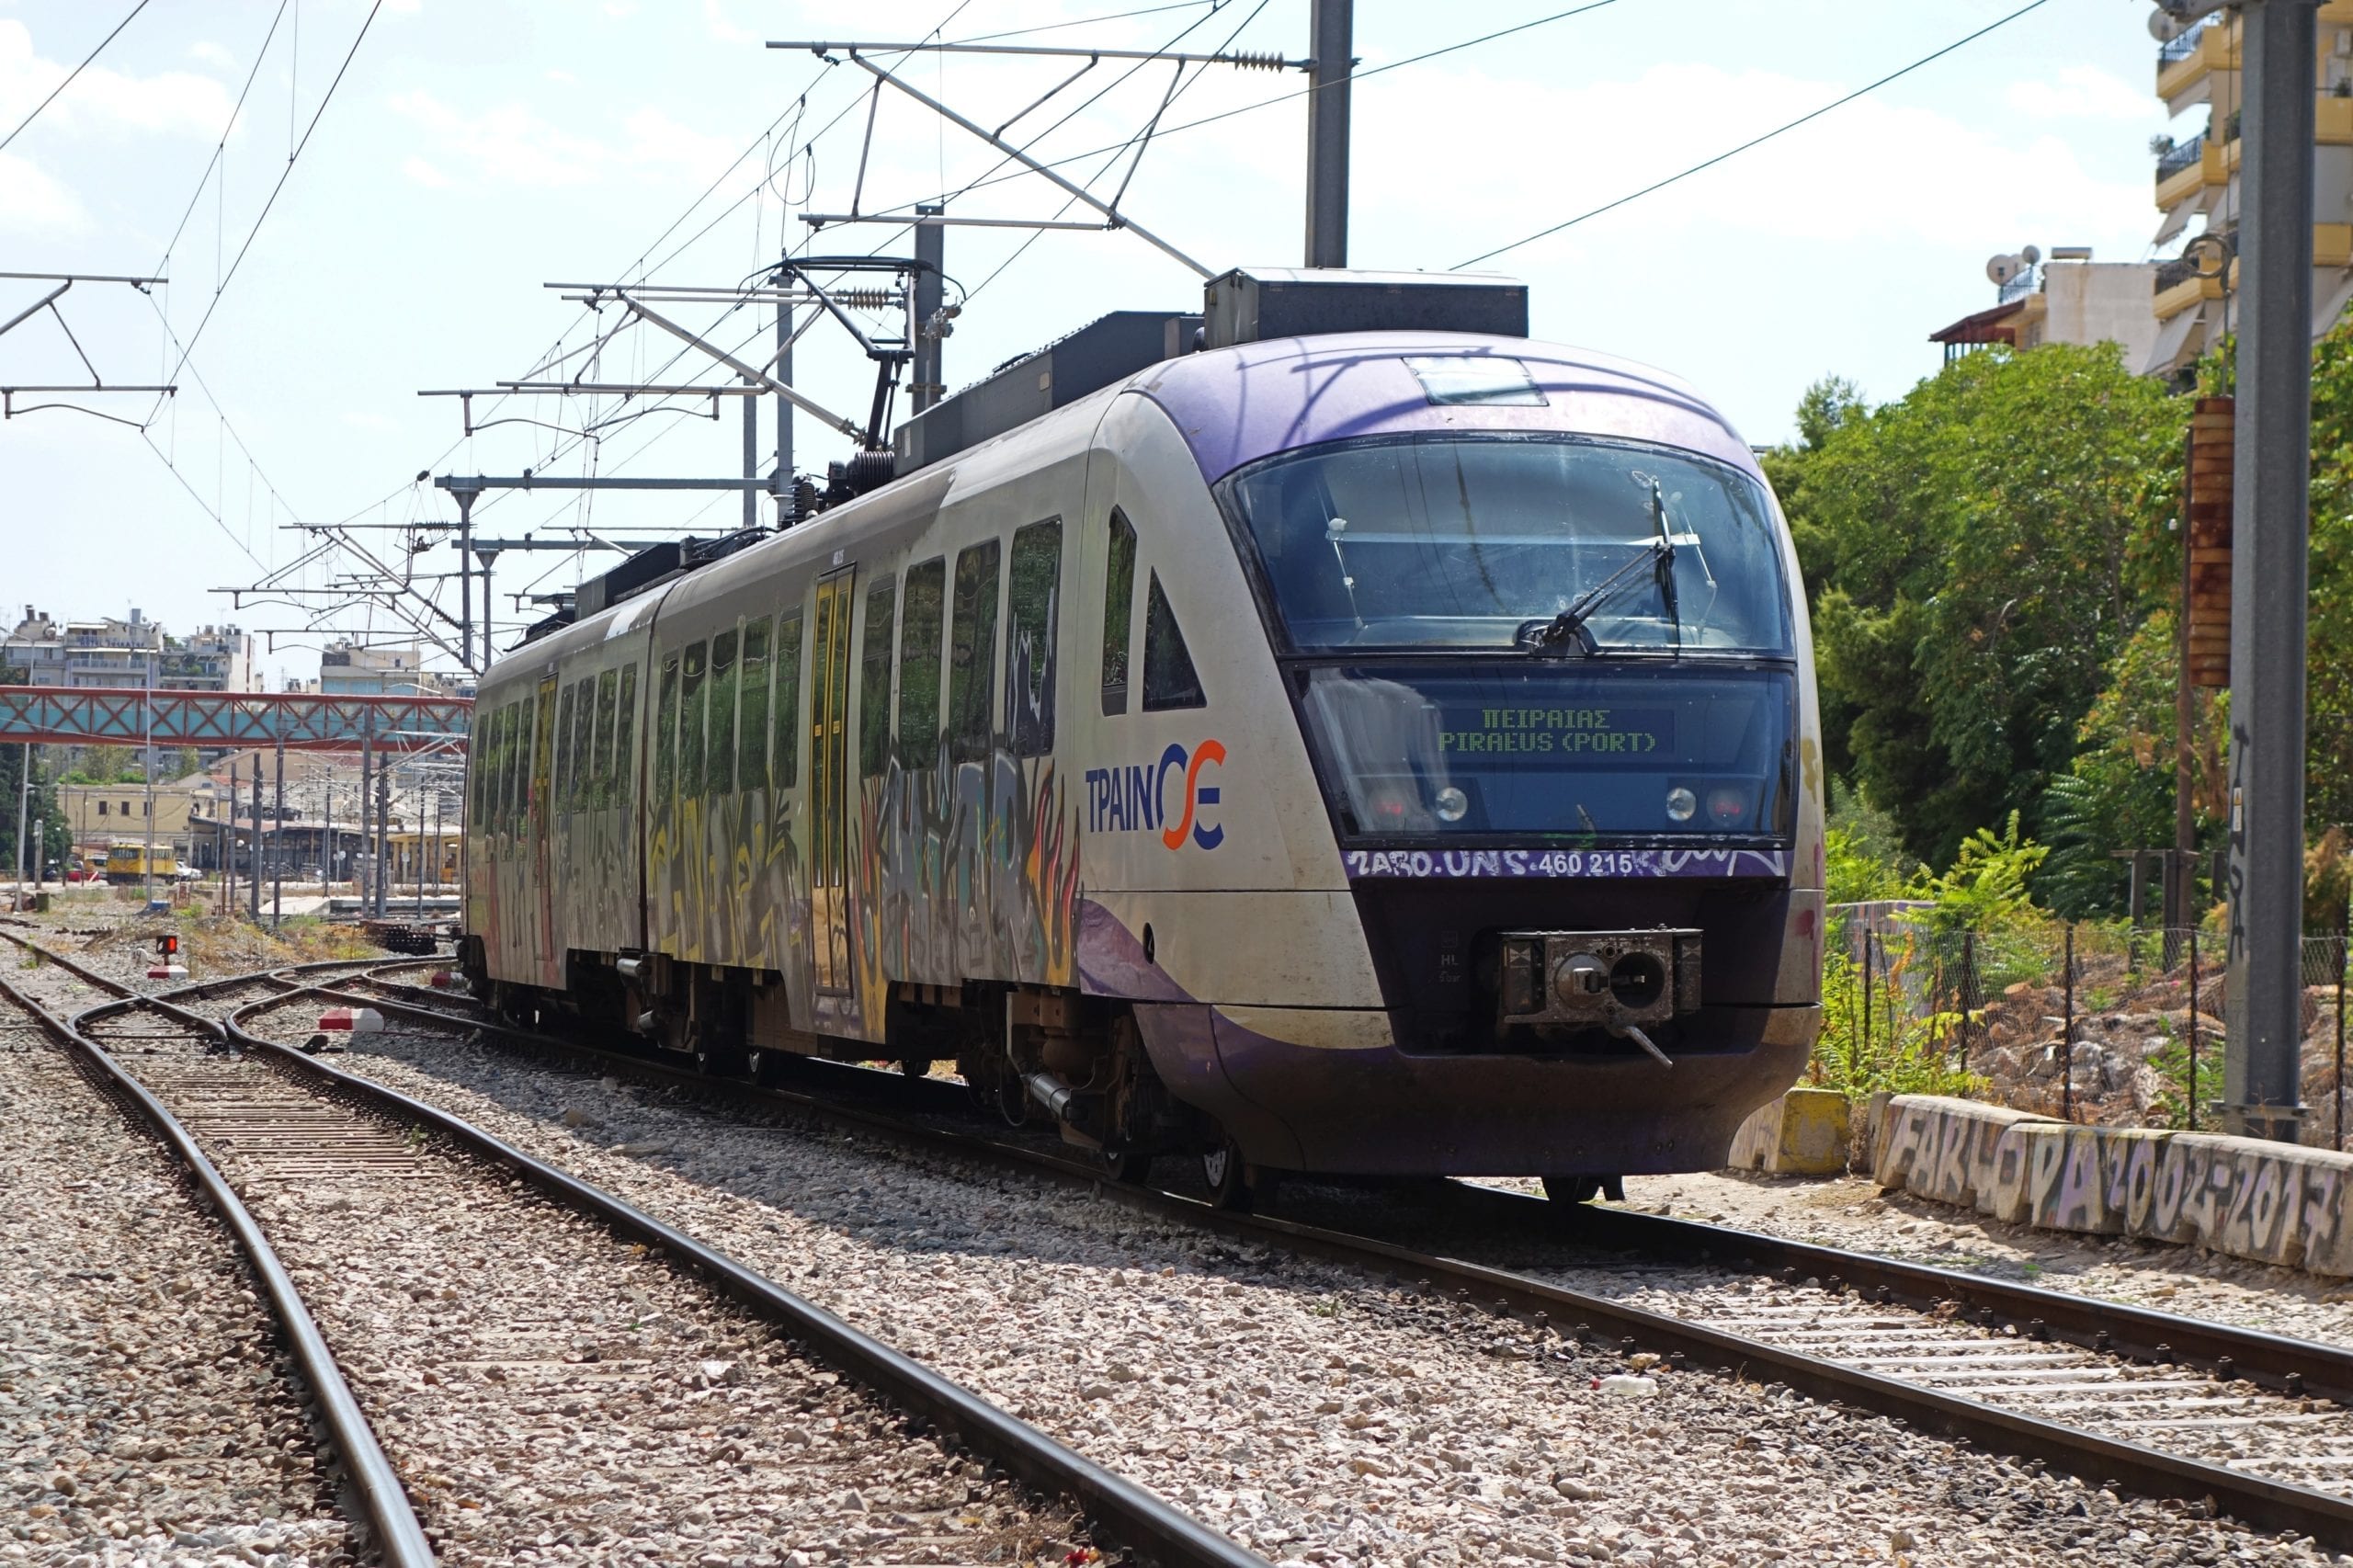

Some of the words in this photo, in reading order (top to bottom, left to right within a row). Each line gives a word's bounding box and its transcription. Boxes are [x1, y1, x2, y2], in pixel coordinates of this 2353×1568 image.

[1482, 710, 1610, 728] ΠΕΙΡΑΙΑΣ
[1438, 733, 1553, 752] PIRAEUS
[1563, 733, 1655, 752] (PORT)
[1539, 854, 1582, 873] 460
[1589, 854, 1633, 873] 215
[1440, 954, 1460, 966] HL
